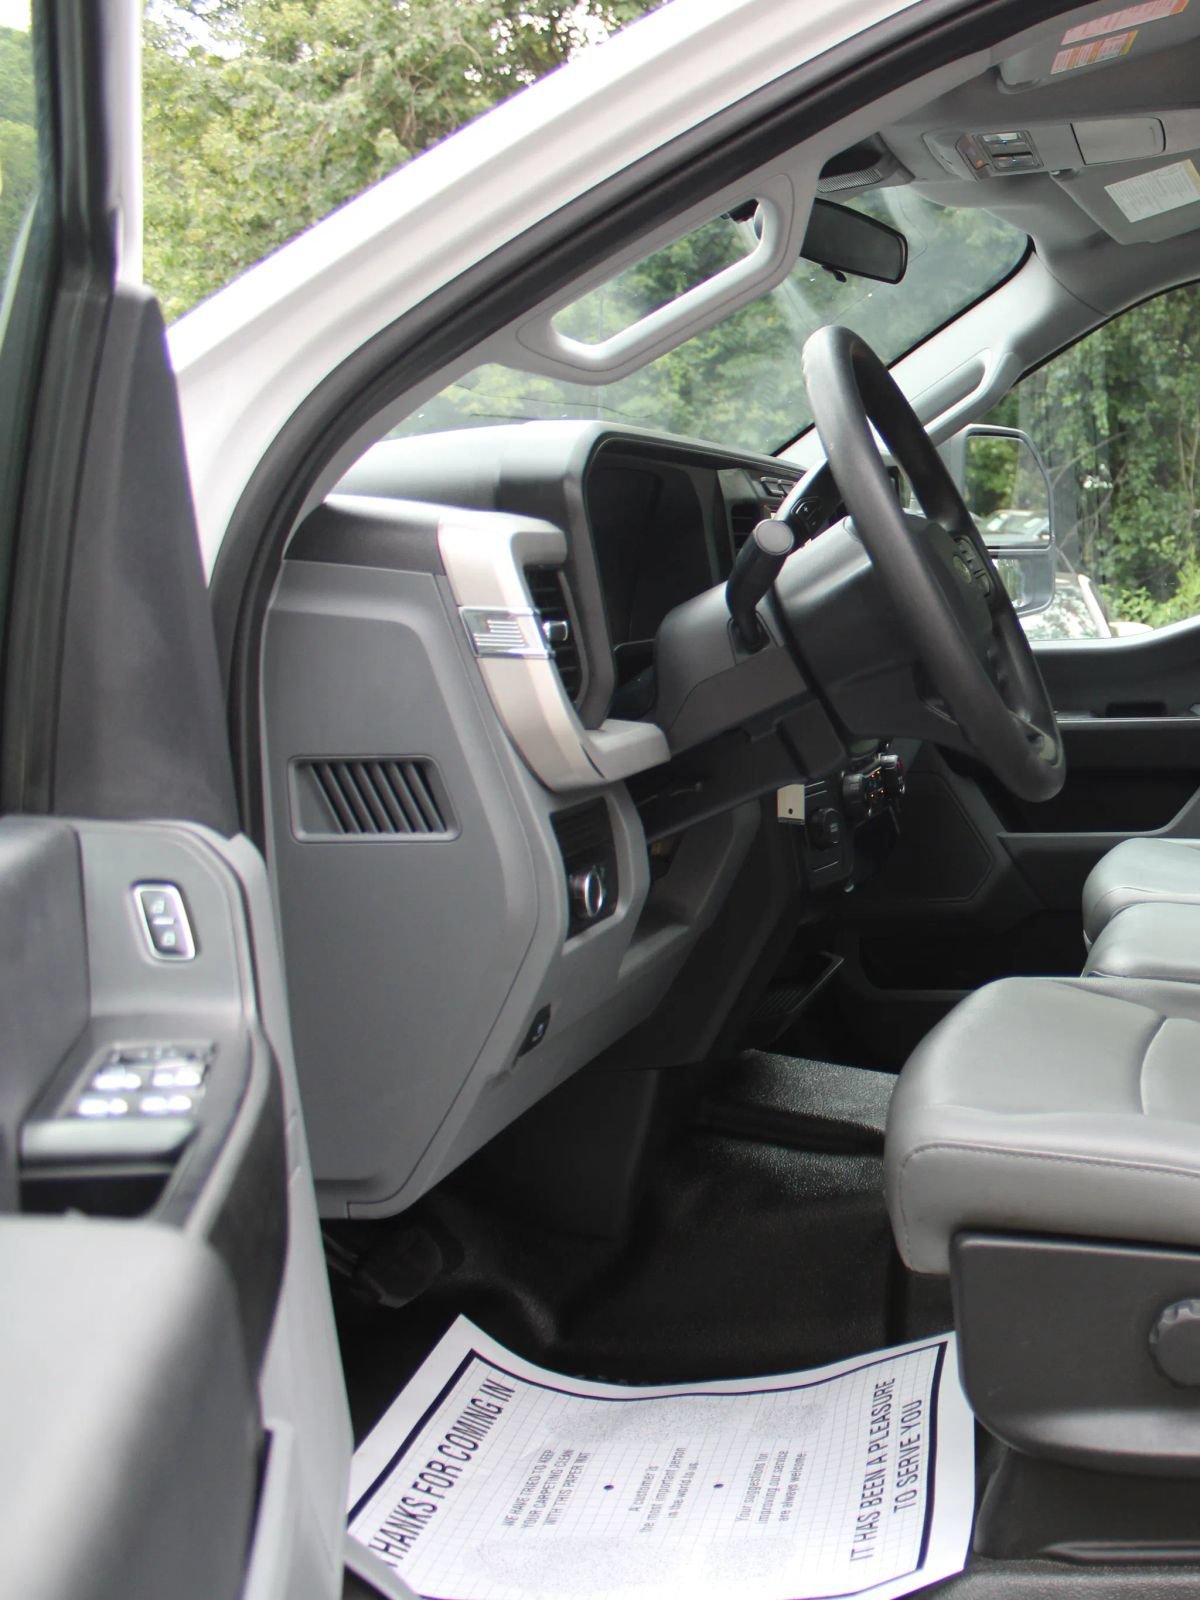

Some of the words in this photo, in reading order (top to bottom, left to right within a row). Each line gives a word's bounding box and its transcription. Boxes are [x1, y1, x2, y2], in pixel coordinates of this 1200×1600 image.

[868, 1377, 896, 1454] PLEASURE
[900, 1399, 923, 1434] YOU
[411, 1460, 463, 1499] FOR
[438, 1397, 504, 1462] COMING
[479, 1378, 516, 1402] IN
[536, 1449, 554, 1464] KEEP
[668, 1447, 687, 1468] person
[866, 1454, 887, 1466] A
[896, 1433, 921, 1488] SERVE
[531, 1465, 547, 1475] TO
[562, 1464, 584, 1487] PAPER
[520, 1475, 541, 1495] TRIED
[520, 1510, 543, 1528] YOUR
[533, 1469, 563, 1508] CARPETING
[554, 1449, 575, 1468] CLEAN
[633, 1472, 656, 1506] customer
[654, 1469, 678, 1502] important
[735, 1505, 752, 1522] Your
[744, 1463, 766, 1503] suggestions
[780, 1484, 799, 1508] always
[860, 1466, 887, 1509] BEEN
[509, 1497, 530, 1515] HAVE
[553, 1489, 573, 1507] THIS
[757, 1488, 780, 1524] improving
[769, 1475, 781, 1487] our
[893, 1489, 918, 1513] TO
[501, 1515, 519, 1526] WE
[543, 1508, 563, 1526] WITH
[646, 1504, 663, 1520] most
[778, 1510, 792, 1522] are
[853, 1511, 881, 1543] HAS
[850, 1547, 875, 1562] IT
